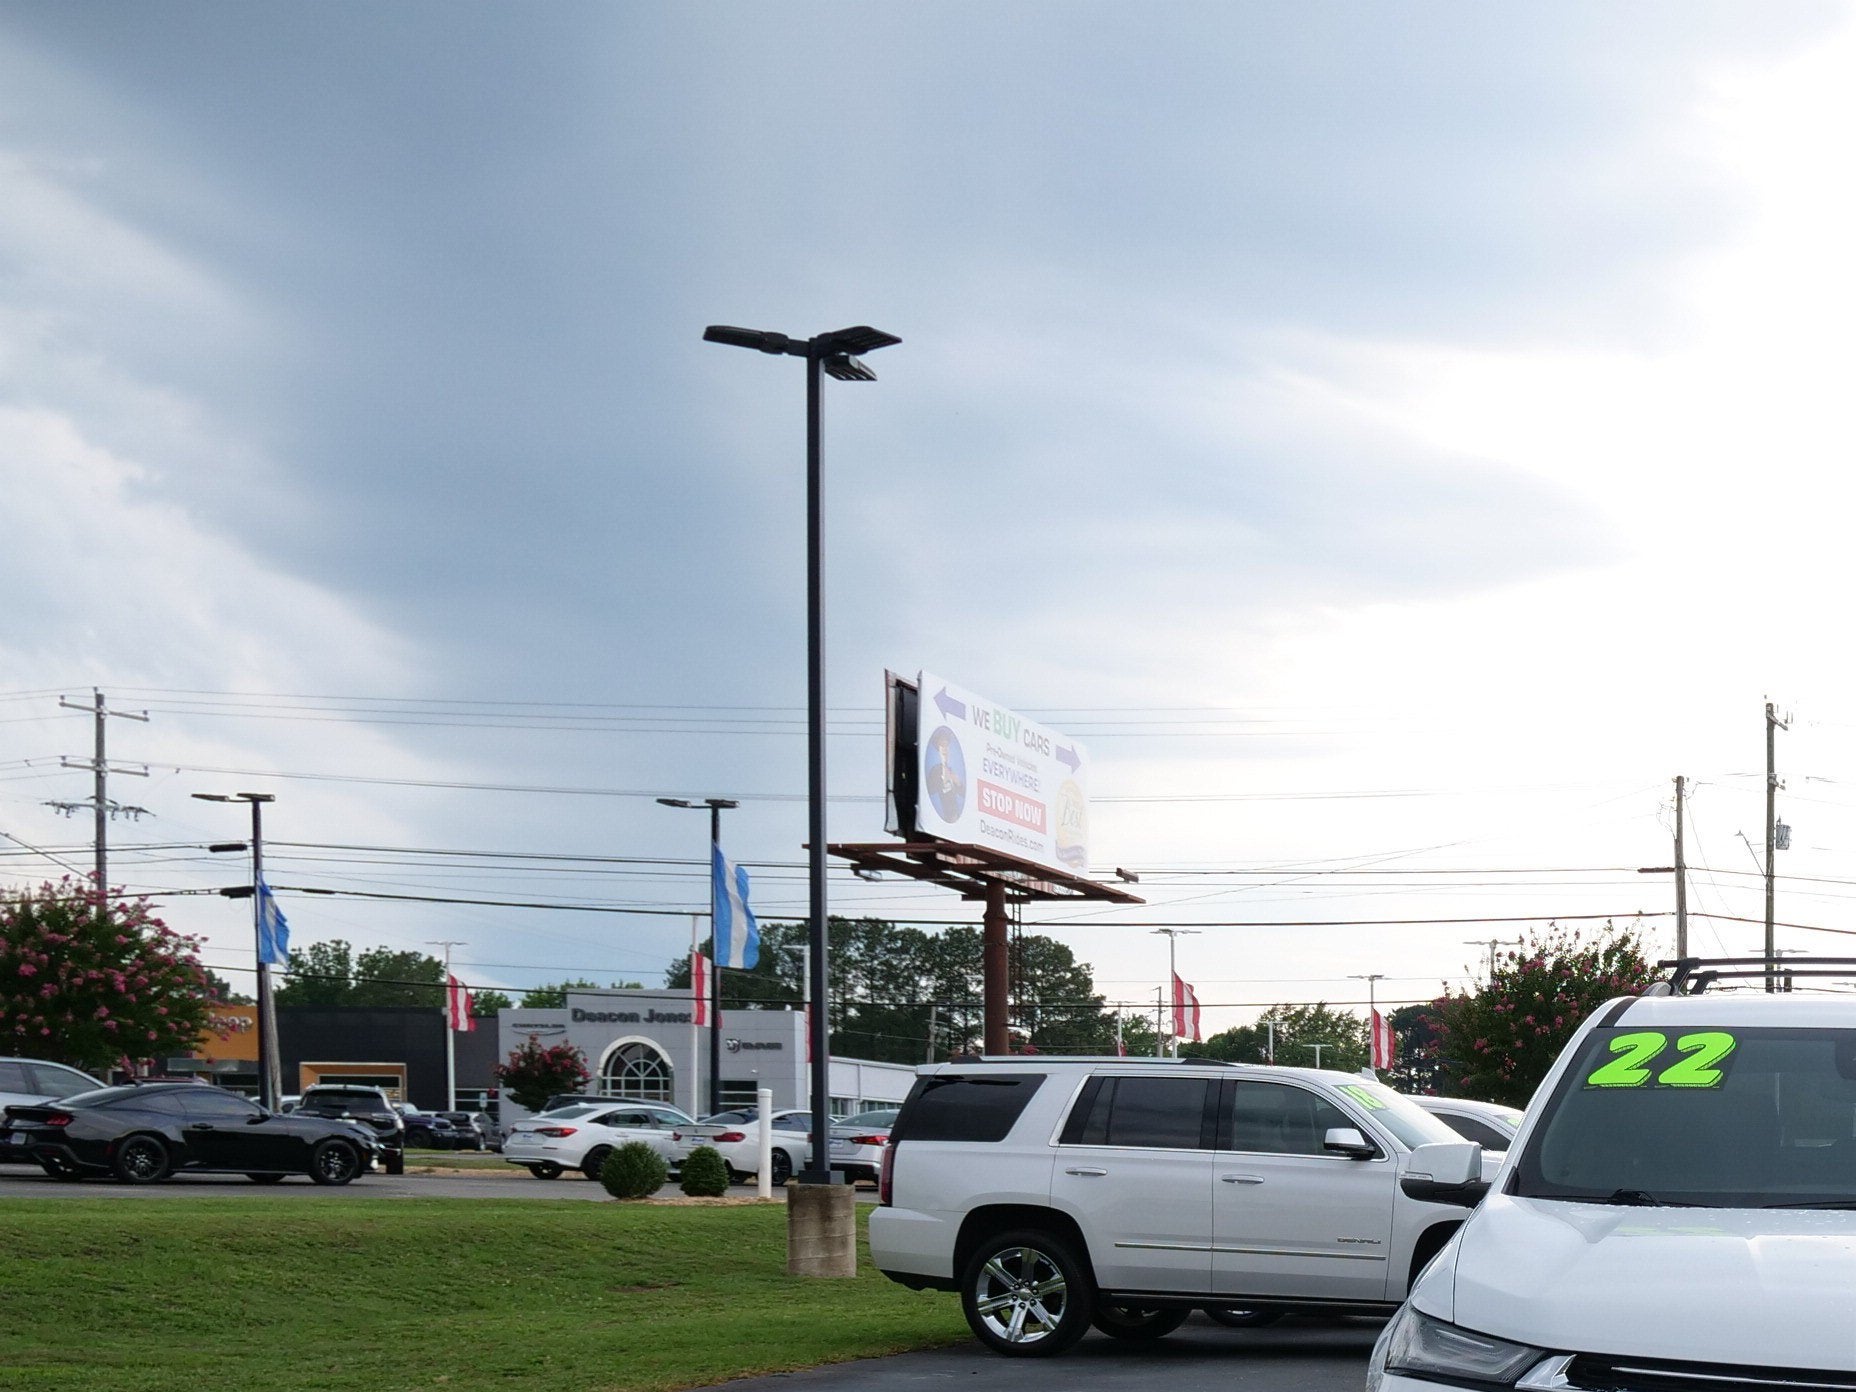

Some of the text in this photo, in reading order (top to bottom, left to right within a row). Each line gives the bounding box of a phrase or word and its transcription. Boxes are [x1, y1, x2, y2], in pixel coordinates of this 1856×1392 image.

[973, 705, 1049, 756] WE BUY CARS
[982, 788, 1041, 826] STOP NOW
[571, 1008, 640, 1023] Deacon
[1588, 1032, 1736, 1087] 22
